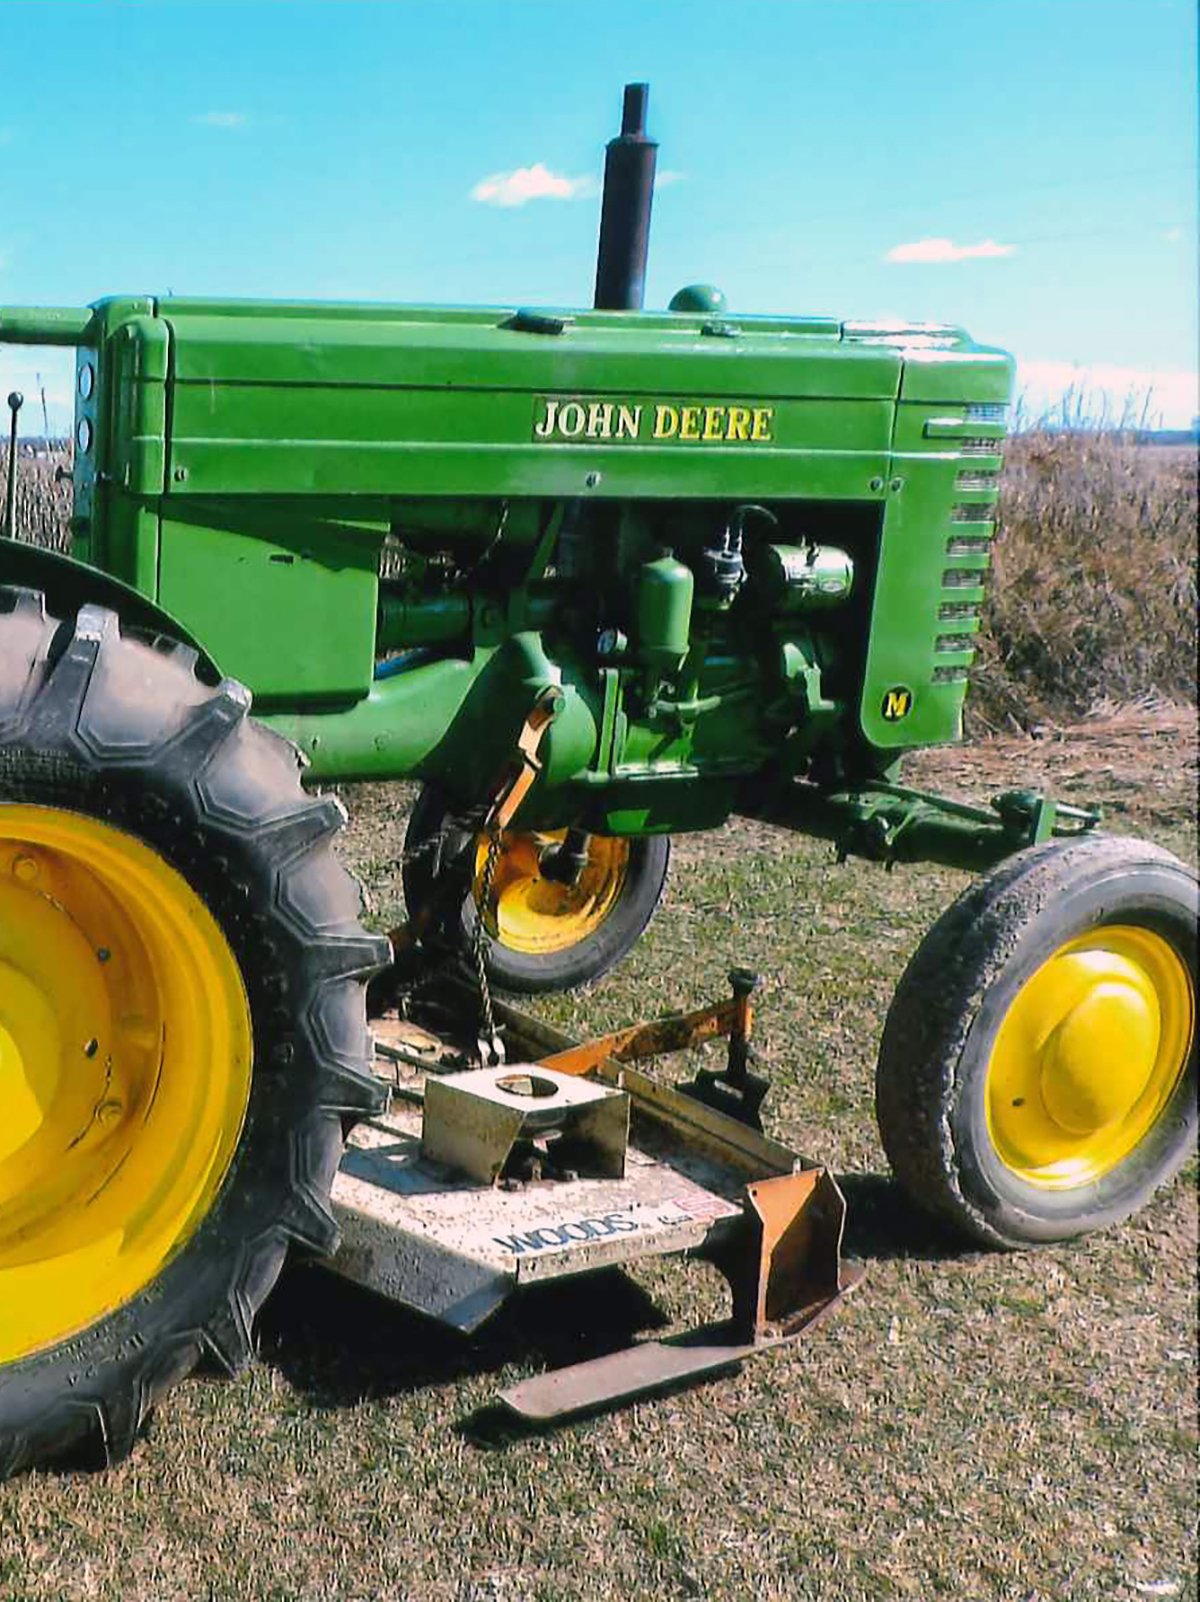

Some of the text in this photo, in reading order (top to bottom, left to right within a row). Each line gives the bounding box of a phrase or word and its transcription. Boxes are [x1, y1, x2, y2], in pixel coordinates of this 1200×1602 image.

[535, 402, 774, 441] JOHN DEERE
[885, 692, 908, 717] M
[493, 1213, 638, 1253] WOODS
